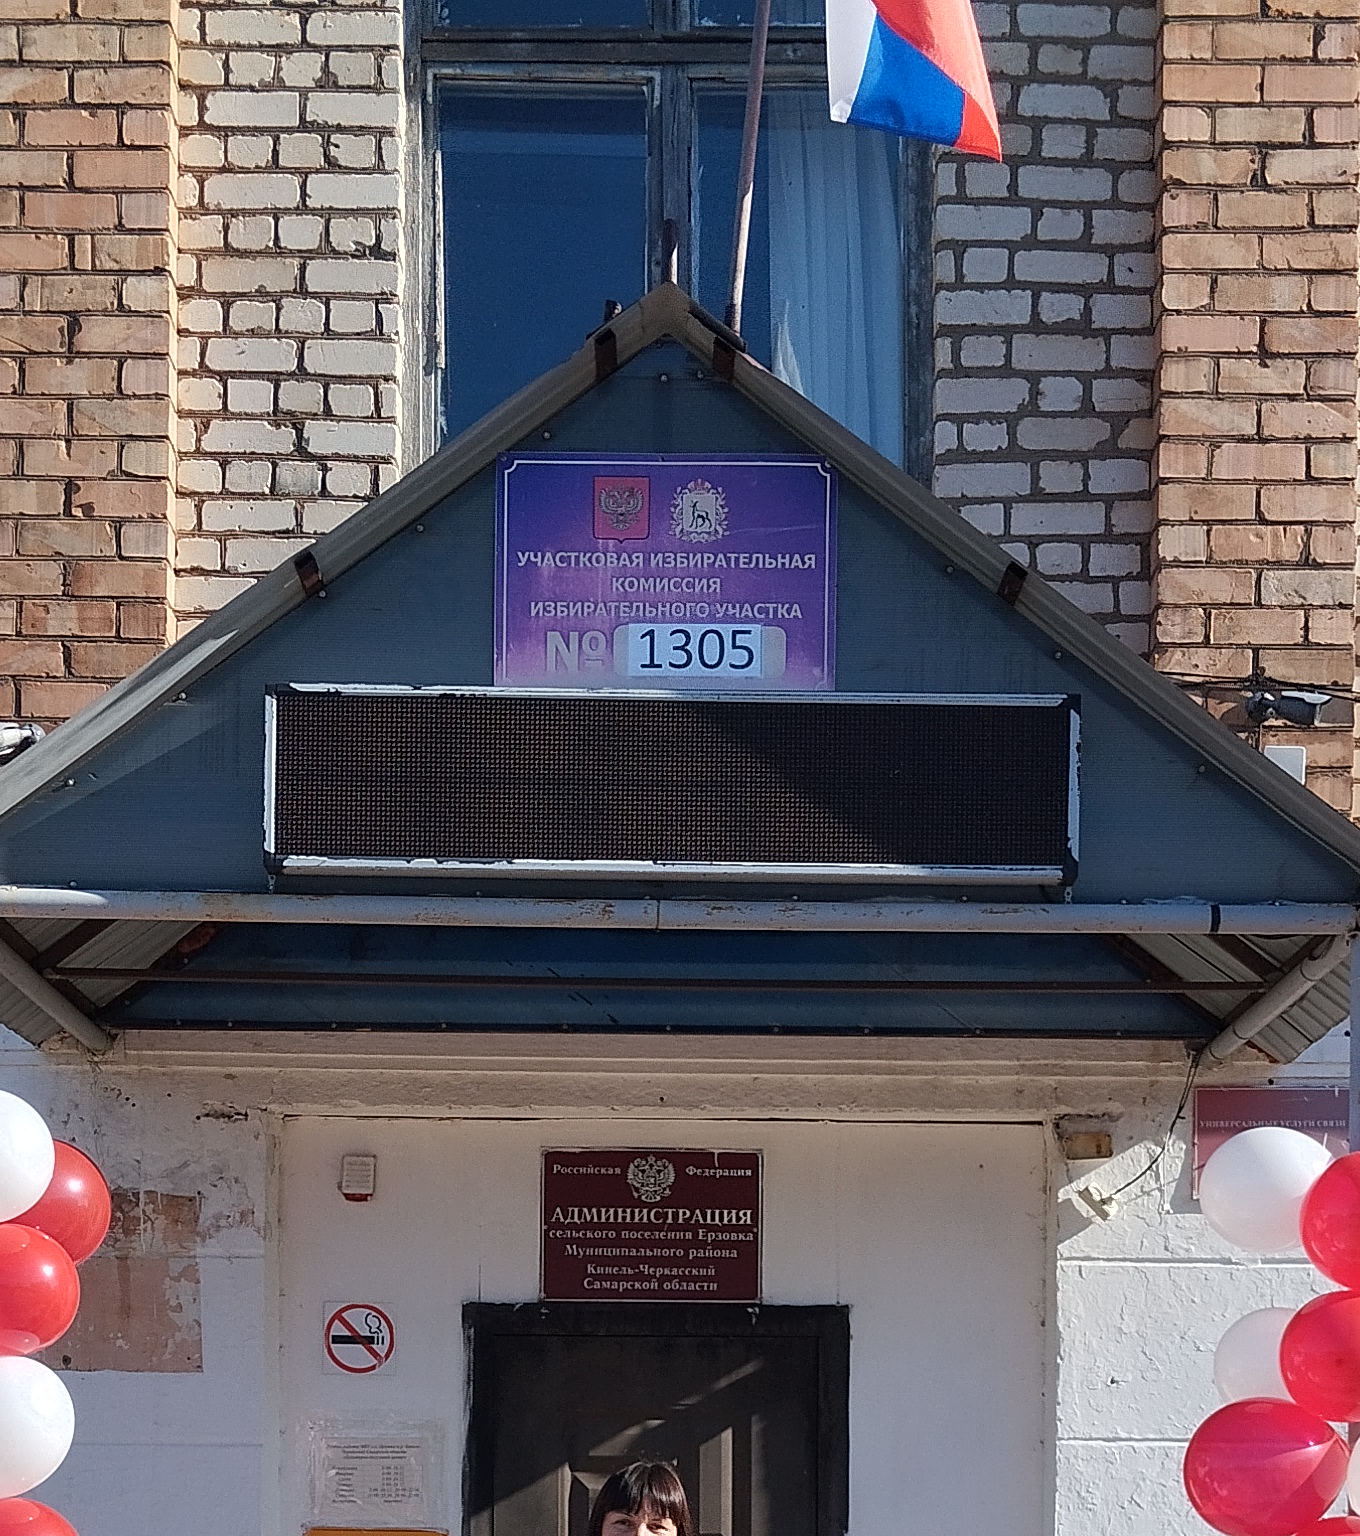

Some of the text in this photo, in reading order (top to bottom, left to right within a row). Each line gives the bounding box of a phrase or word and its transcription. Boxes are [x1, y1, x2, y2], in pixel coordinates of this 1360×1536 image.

[517, 551, 816, 569] УЧАСТКОВАЯ ИЗБИРАТЕЛЬНАЯ
[612, 577, 721, 593] КОМИССИЯ
[530, 602, 803, 620] ИЗБИРАТЕЛЬНОГО УЧАСТКА
[545, 628, 755, 674] № 1305
[552, 1164, 752, 1178] Российская Федерация
[550, 1206, 753, 1227] АДМИНИСТРАЦИЯ
[549, 1229, 754, 1243] сельского поселения Ерзовка
[564, 1244, 738, 1260] Муниципального района
[586, 1263, 716, 1278] Кинель-Черкасский
[583, 1278, 718, 1292] Самарской области
